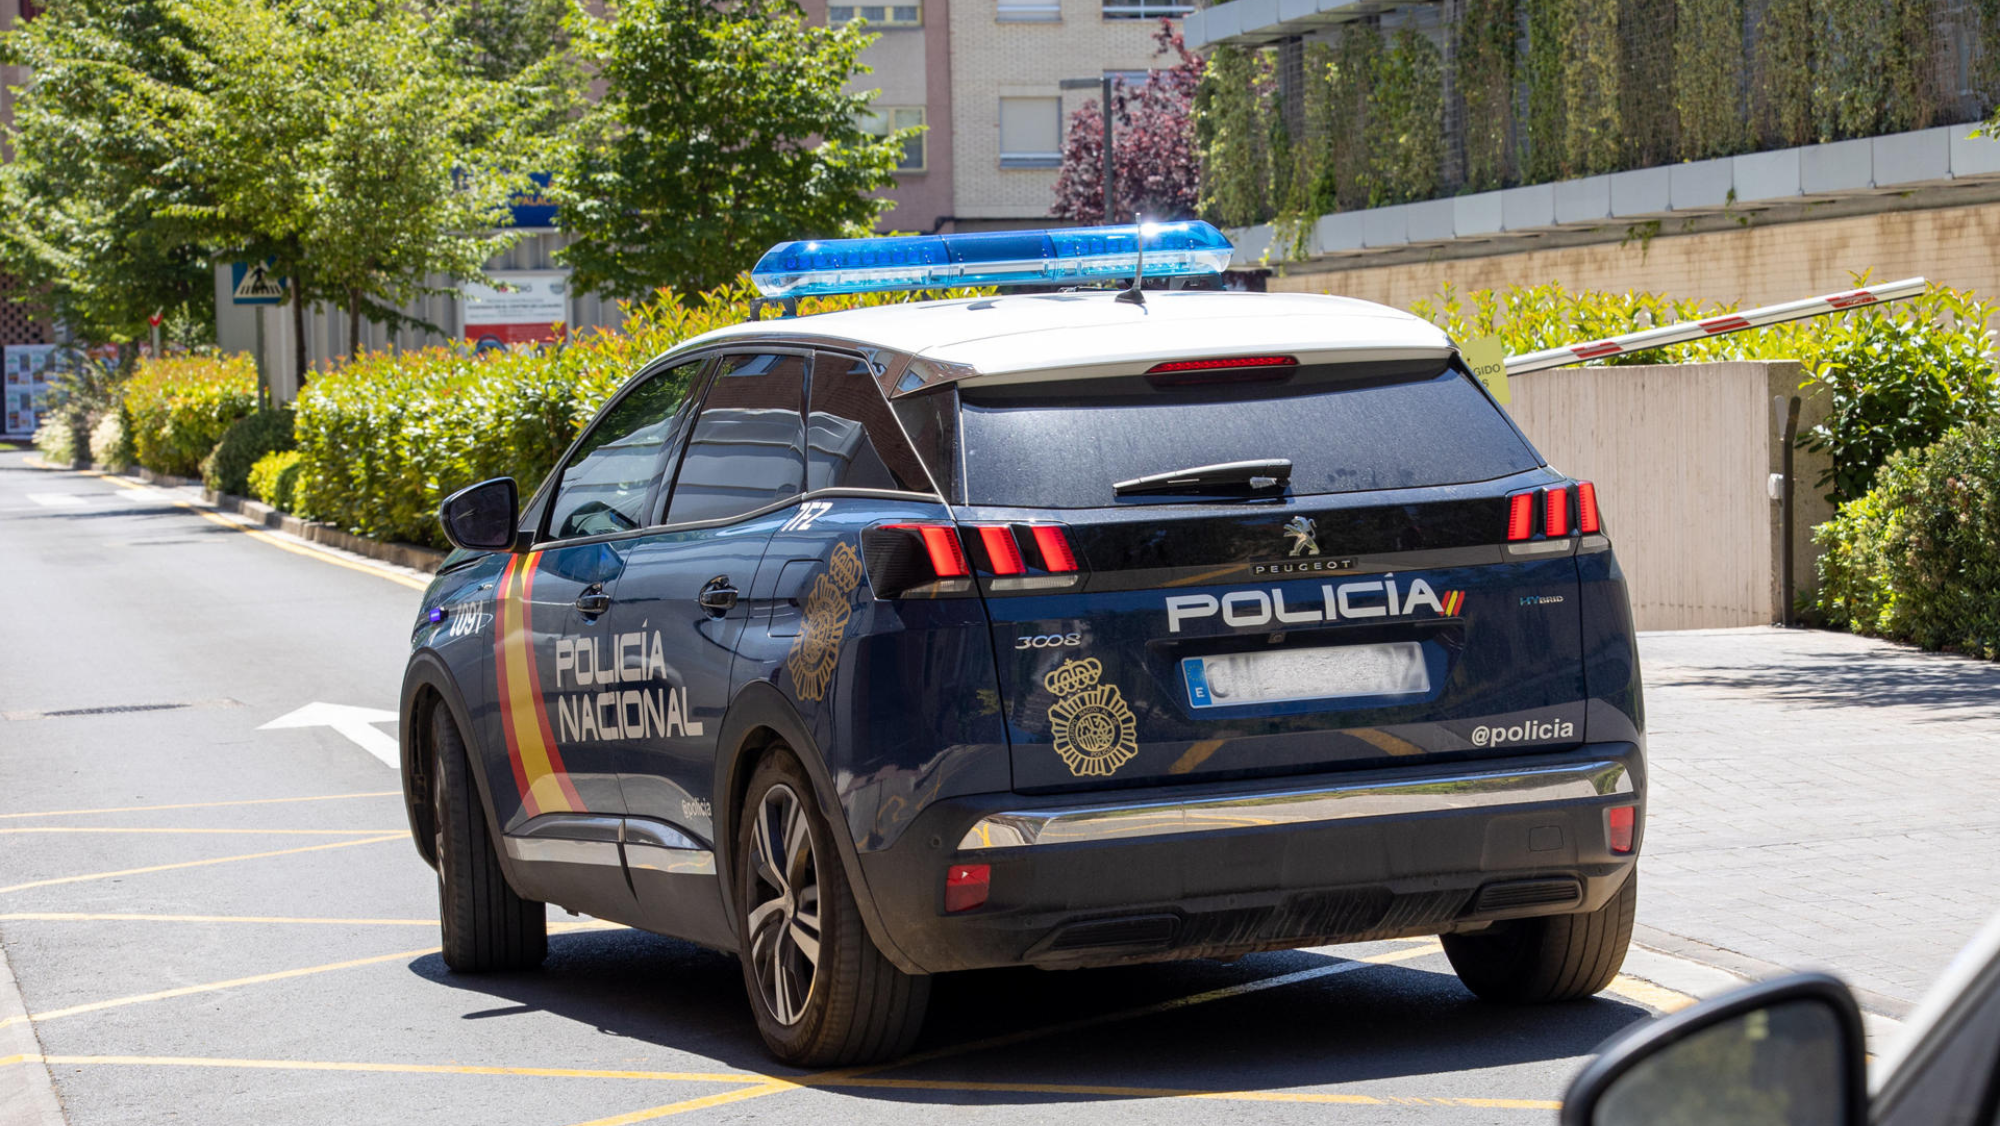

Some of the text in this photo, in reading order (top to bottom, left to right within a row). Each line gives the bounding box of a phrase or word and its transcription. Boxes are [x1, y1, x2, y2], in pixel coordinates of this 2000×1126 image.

[1256, 560, 1351, 574] PEUGEOT
[1166, 572, 1444, 632] POLICÍA
[1520, 595, 1564, 606] HYBRID
[556, 618, 667, 687] POLICÍA
[1015, 633, 1081, 650] 3008
[1195, 687, 1205, 698] E
[558, 686, 703, 743] NACIONAL
[1471, 718, 1574, 747] @policia
